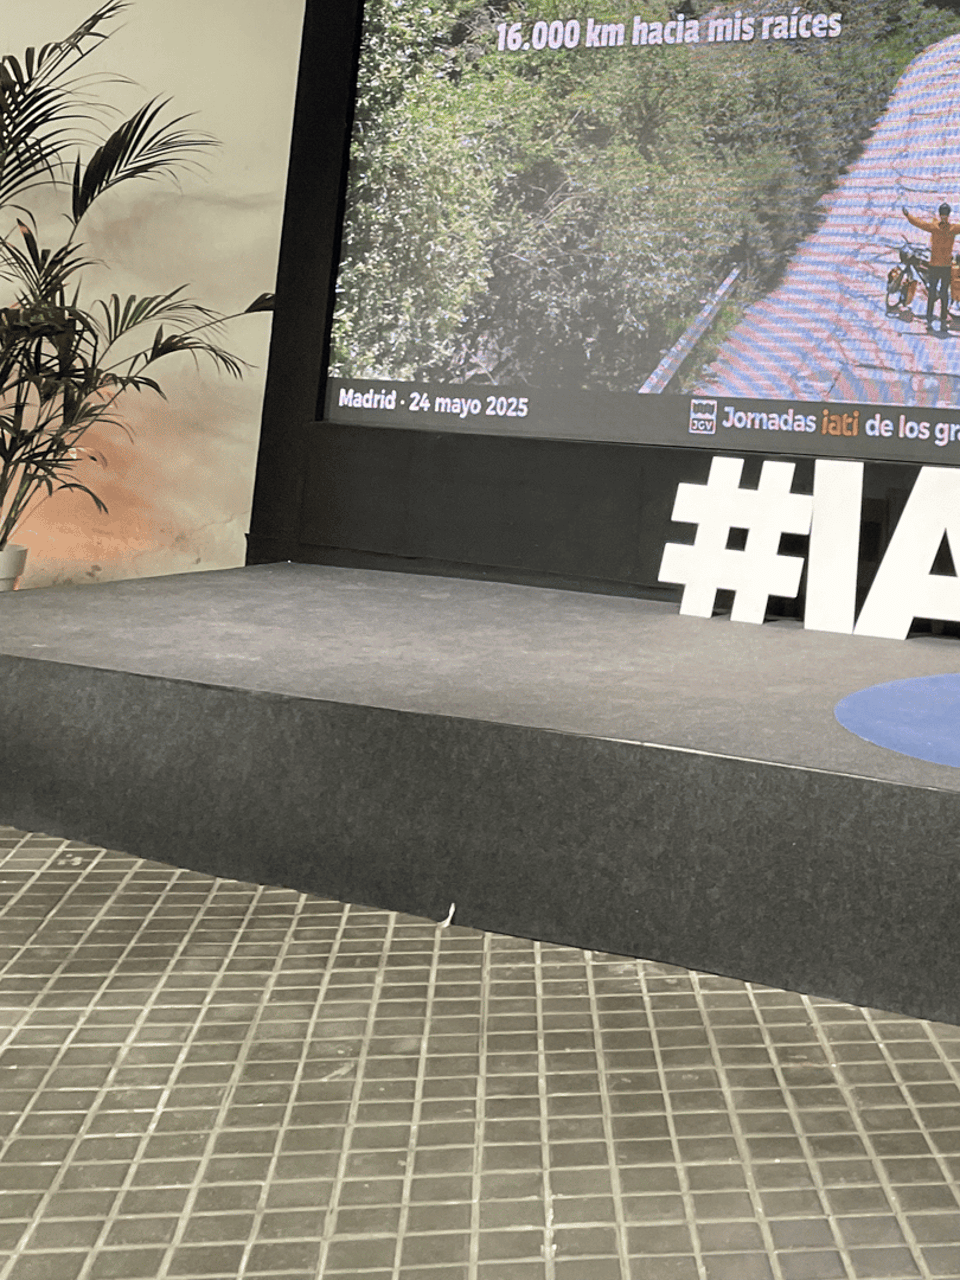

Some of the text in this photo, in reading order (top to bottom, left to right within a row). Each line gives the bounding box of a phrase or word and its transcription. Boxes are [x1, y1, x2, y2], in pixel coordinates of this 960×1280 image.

[497, 8, 843, 51] 16.000 km hacia mis raíces
[339, 387, 397, 410] Madrid
[408, 391, 431, 412] 24
[434, 396, 482, 418] mayo
[485, 395, 529, 417] 2025
[692, 420, 713, 430] JGV
[722, 406, 817, 433] Jornadas
[821, 408, 860, 437] iati
[865, 413, 894, 437] de
[898, 414, 931, 439] los
